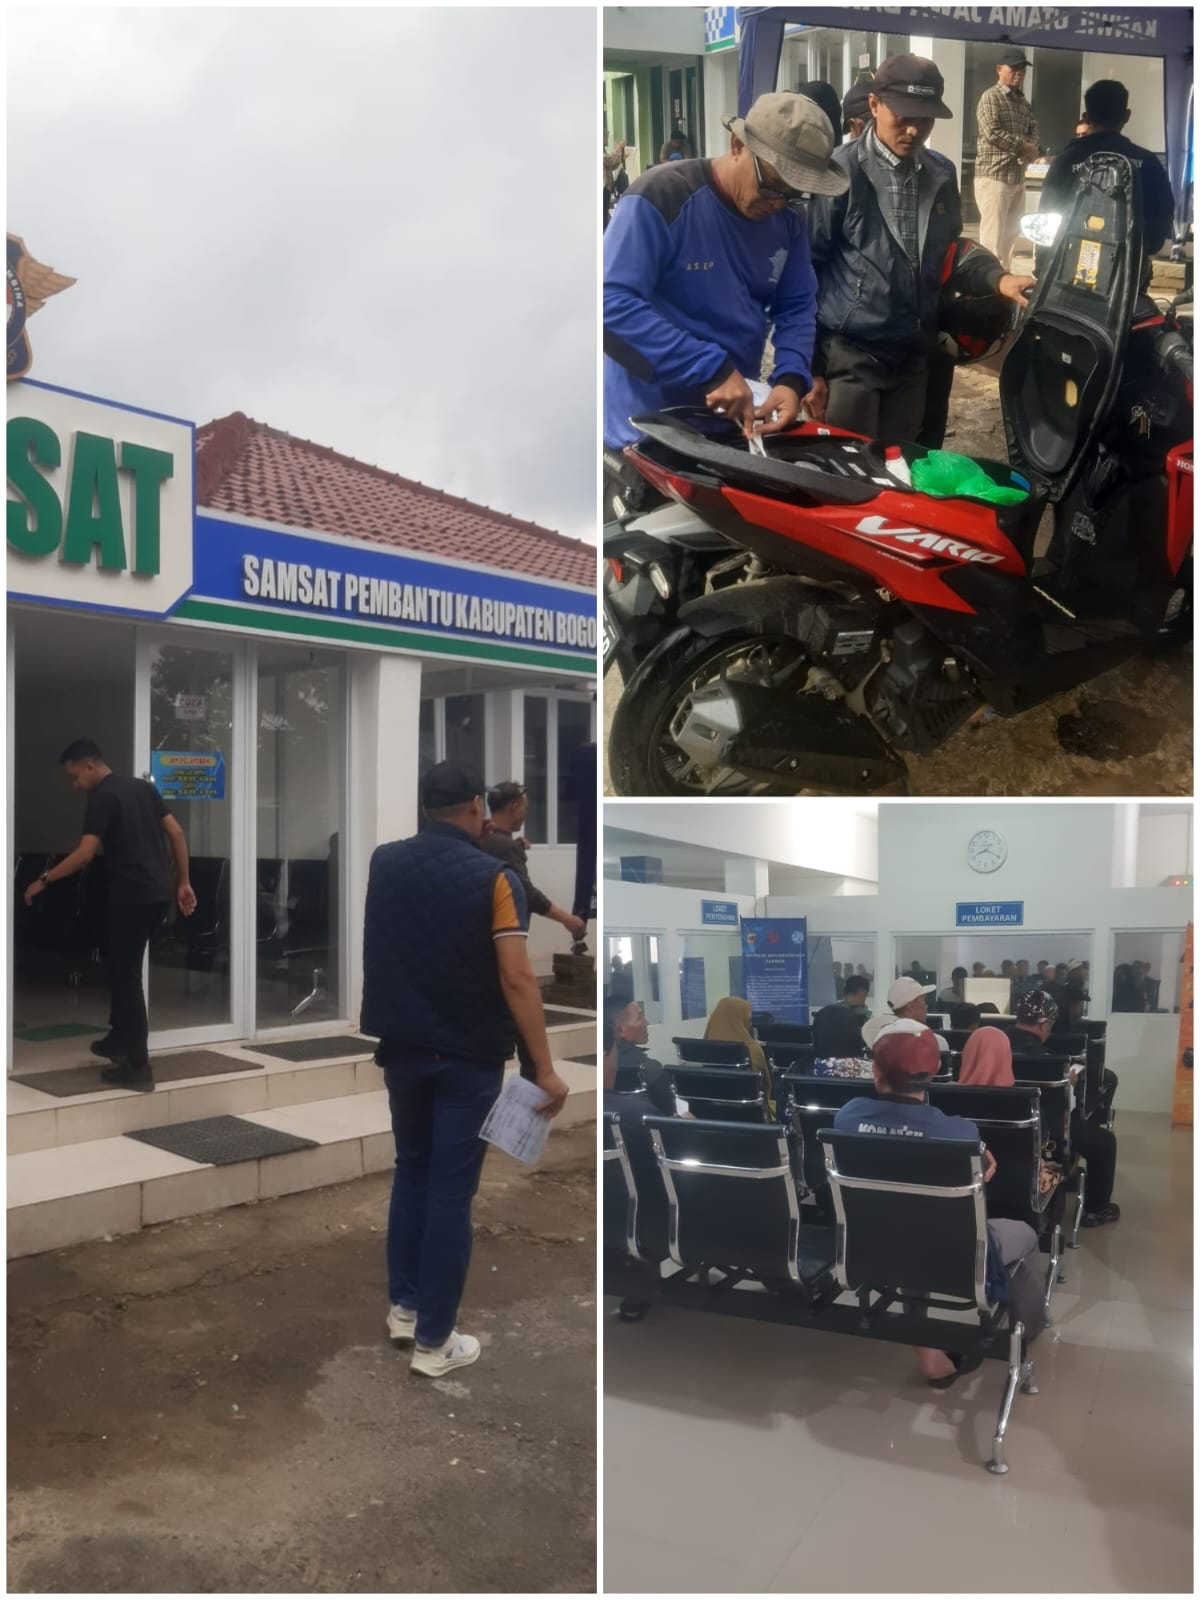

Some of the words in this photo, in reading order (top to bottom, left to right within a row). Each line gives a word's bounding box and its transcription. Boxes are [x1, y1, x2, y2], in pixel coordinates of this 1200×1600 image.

[6, 415, 174, 576] SAT
[855, 515, 1006, 564] VARIO
[243, 554, 341, 609] SAMSAT
[345, 573, 453, 627] PEMBANTU
[455, 593, 553, 643] KABUPATEN
[556, 611, 597, 649] BOGO
[961, 914, 1017, 923] PEMBAYARAN
[975, 906, 1001, 914] LOKET
